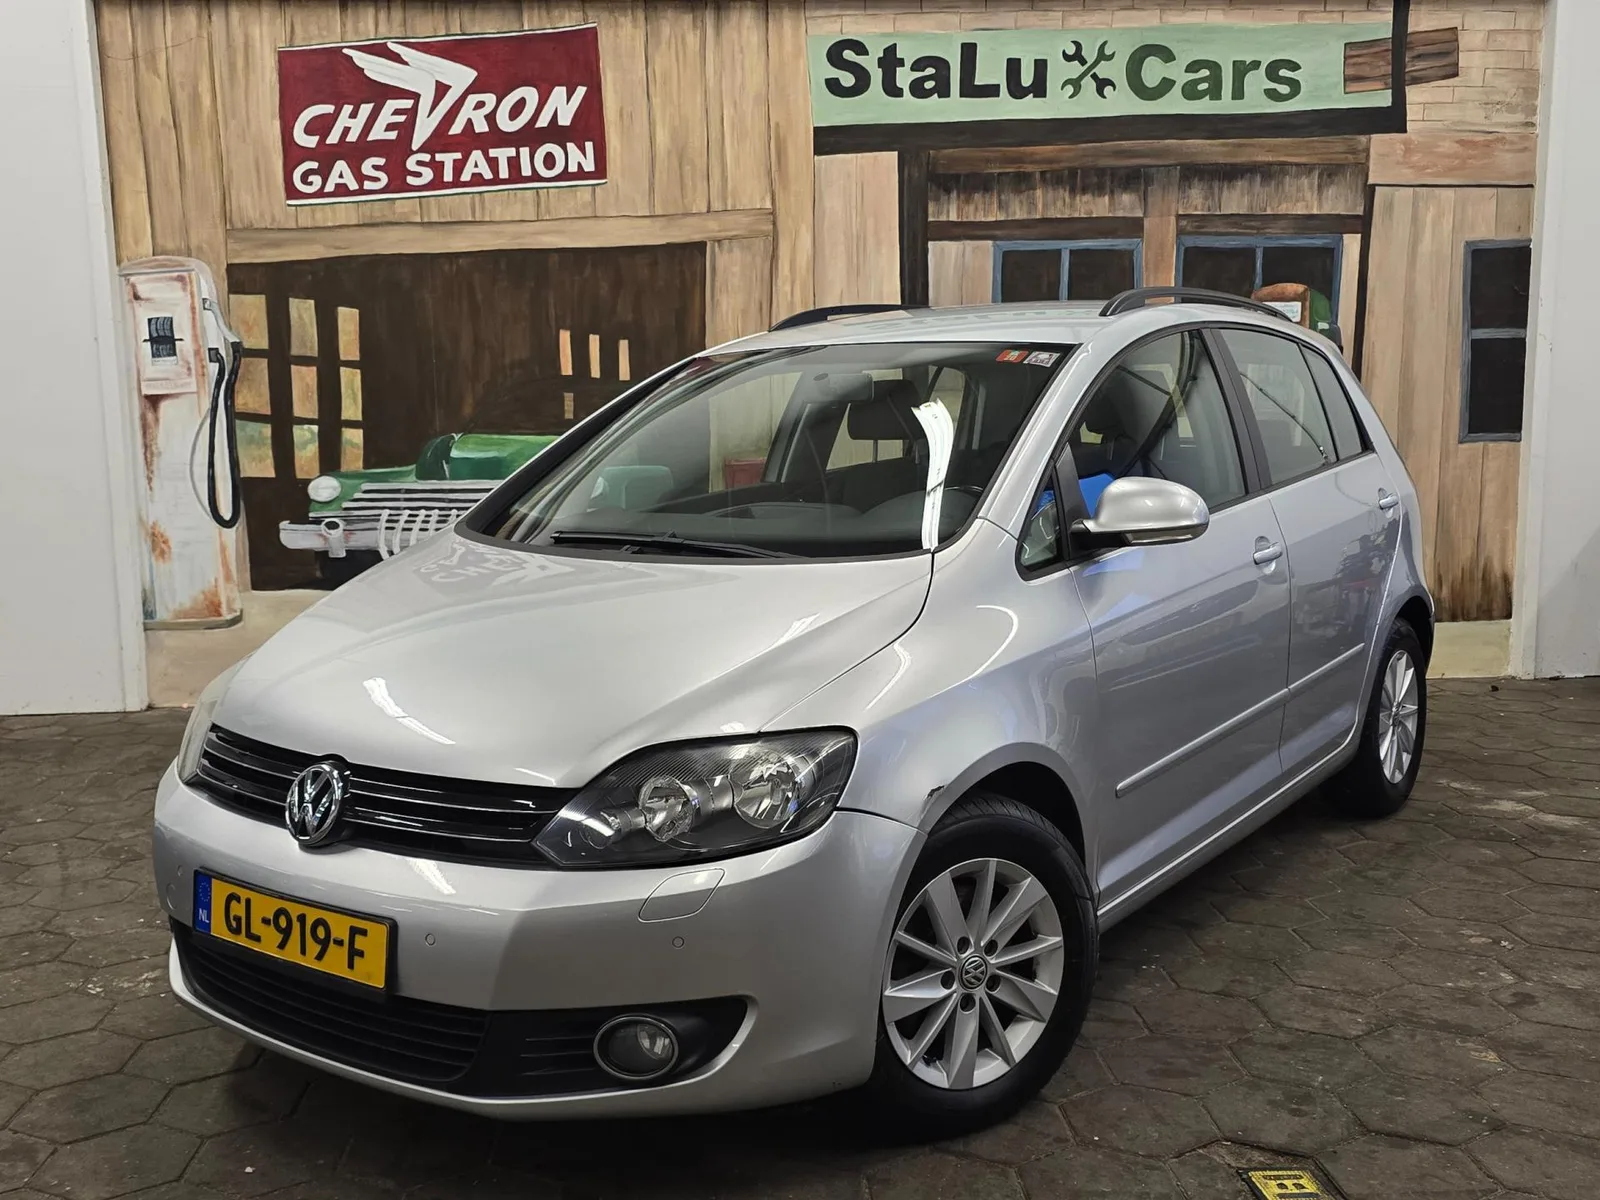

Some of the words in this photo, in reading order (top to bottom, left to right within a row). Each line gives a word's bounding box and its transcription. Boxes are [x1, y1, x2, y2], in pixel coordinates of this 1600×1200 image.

[824, 38, 1048, 100] StaLu
[1125, 43, 1303, 102] Cars
[293, 70, 587, 151] CHEVRON
[292, 157, 389, 194] GAS
[405, 141, 595, 186] STATION
[198, 907, 210, 924] NL
[224, 892, 368, 970] GL-919-F
